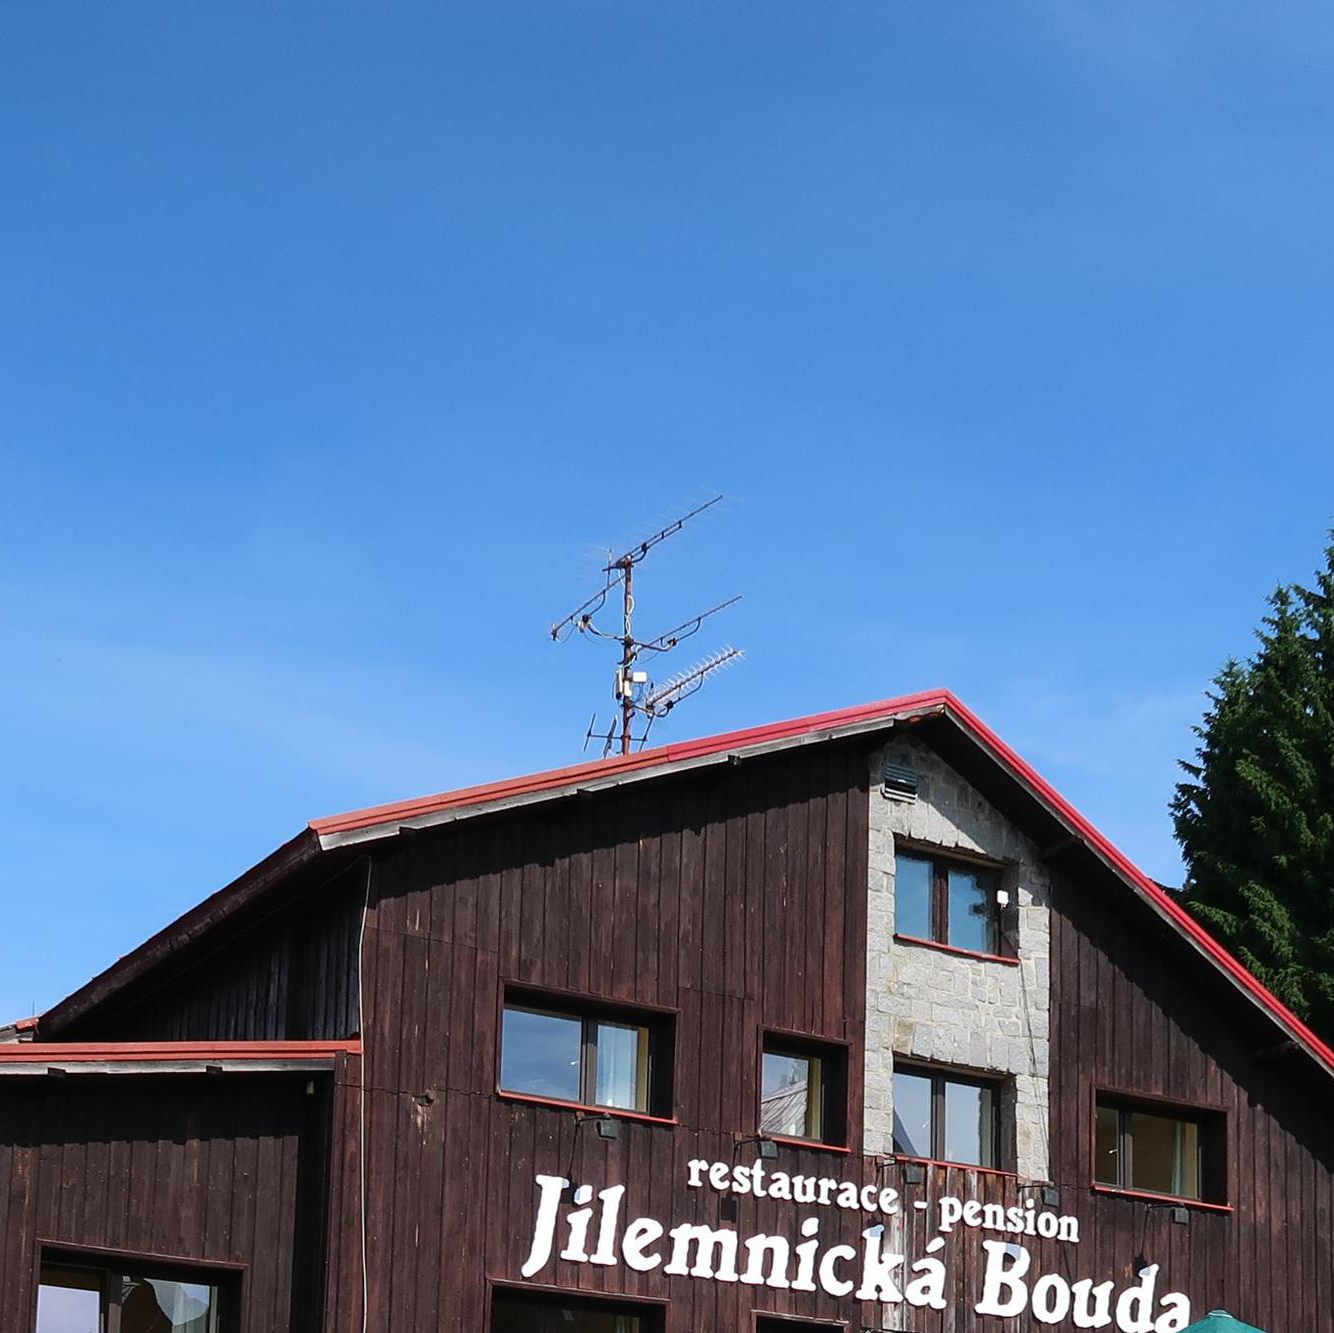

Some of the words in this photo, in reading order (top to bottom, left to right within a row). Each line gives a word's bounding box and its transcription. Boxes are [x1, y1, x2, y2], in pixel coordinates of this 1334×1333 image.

[521, 1174, 948, 1310] Jilemnická
[687, 1158, 899, 1214] restaurace
[938, 1172, 1080, 1243] pension
